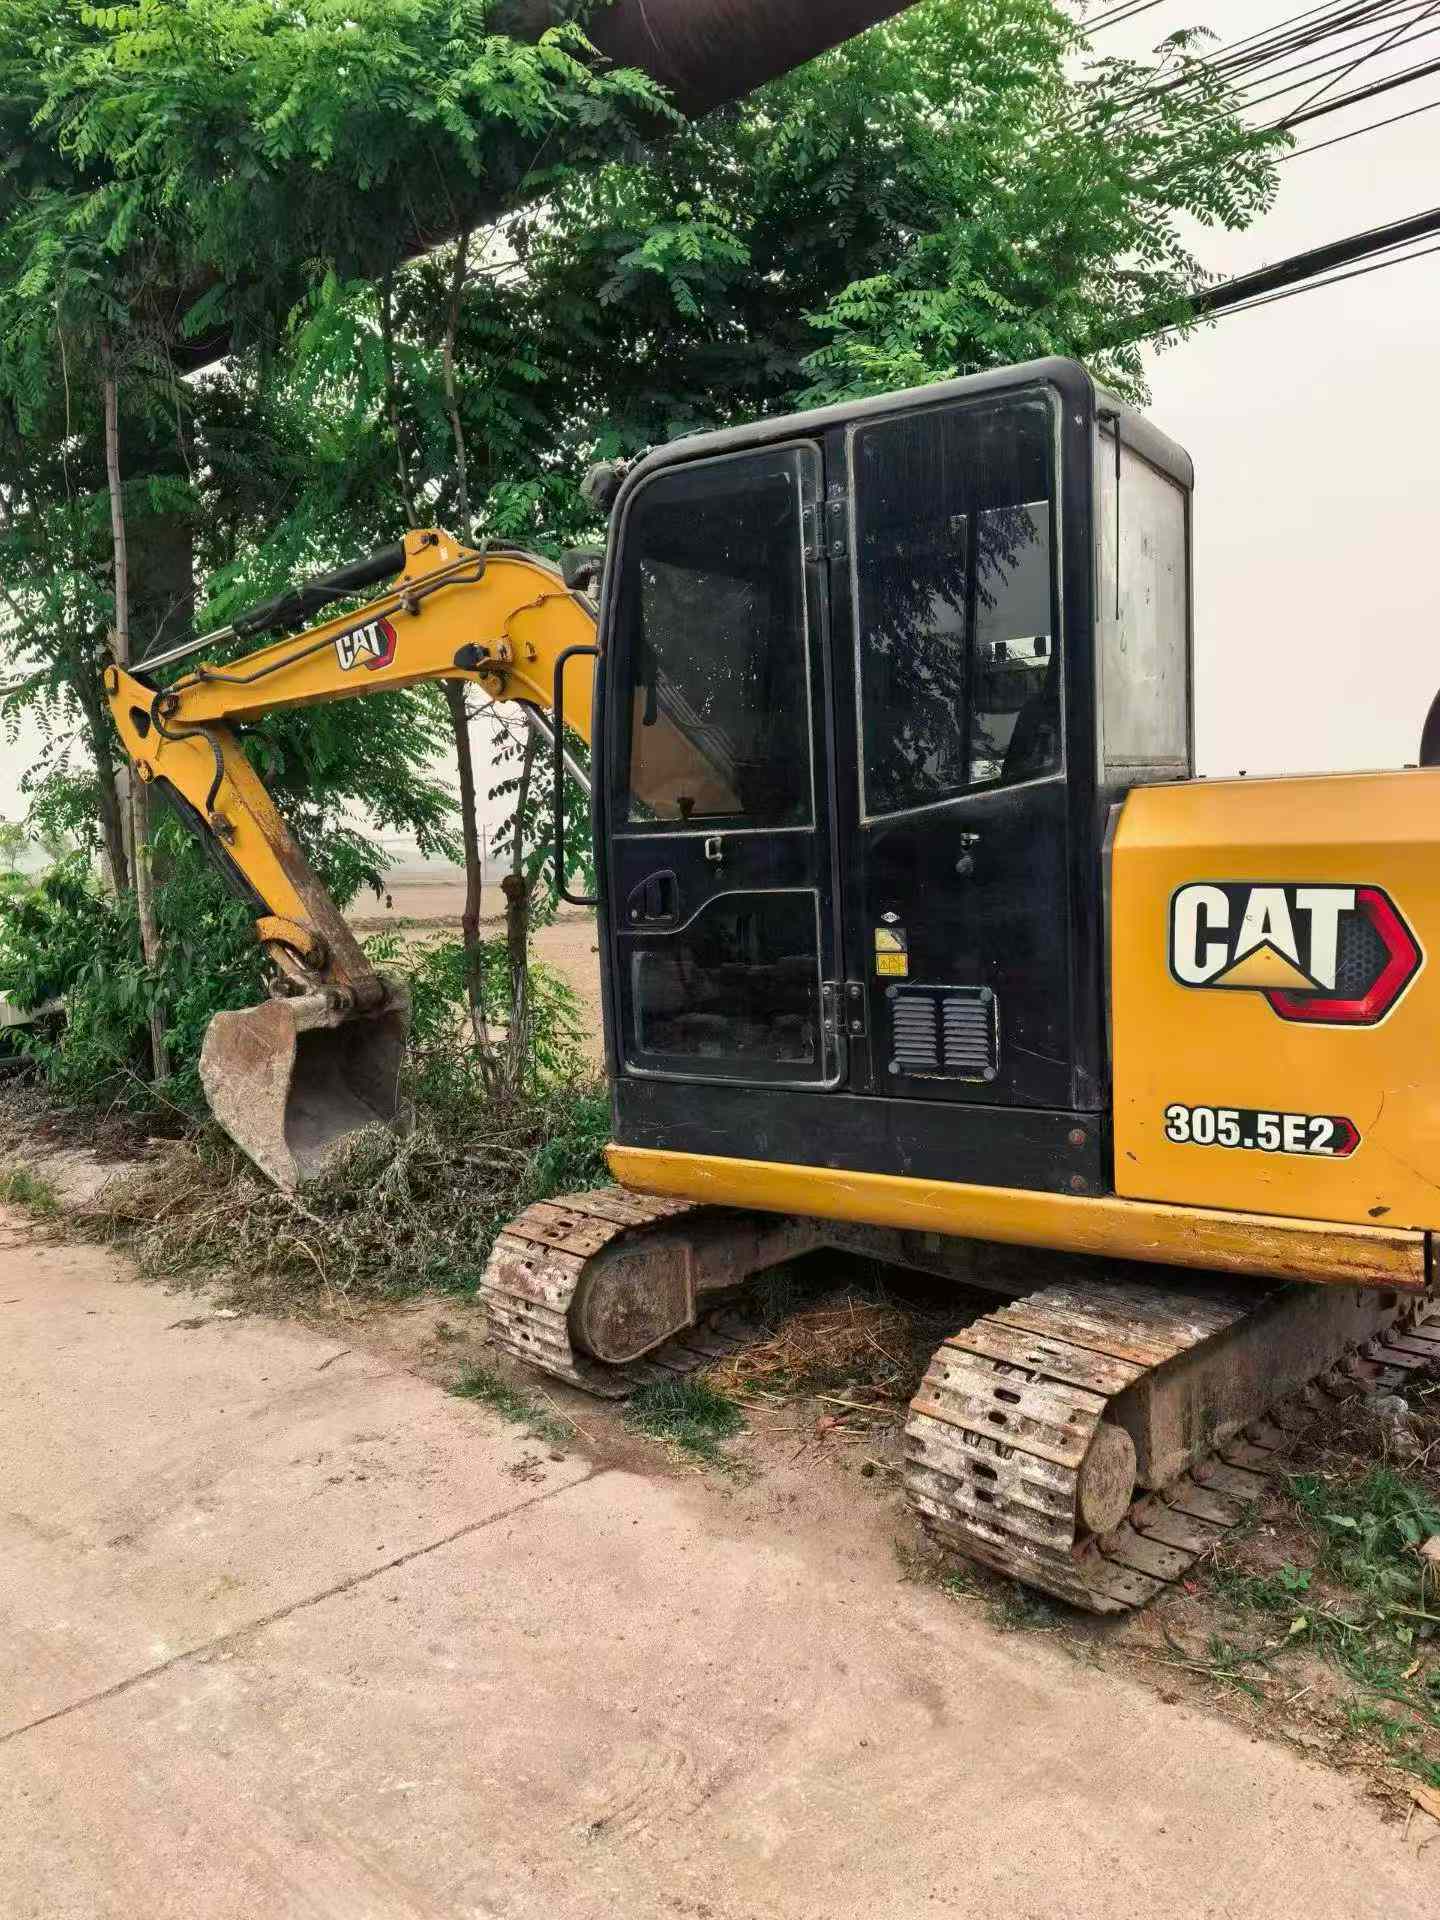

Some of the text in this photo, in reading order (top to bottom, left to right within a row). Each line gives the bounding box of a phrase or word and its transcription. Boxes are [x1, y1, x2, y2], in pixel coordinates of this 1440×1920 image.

[336, 621, 380, 669] CAT
[1174, 886, 1355, 989] CAT
[1167, 1105, 1334, 1153] 305.5E2
